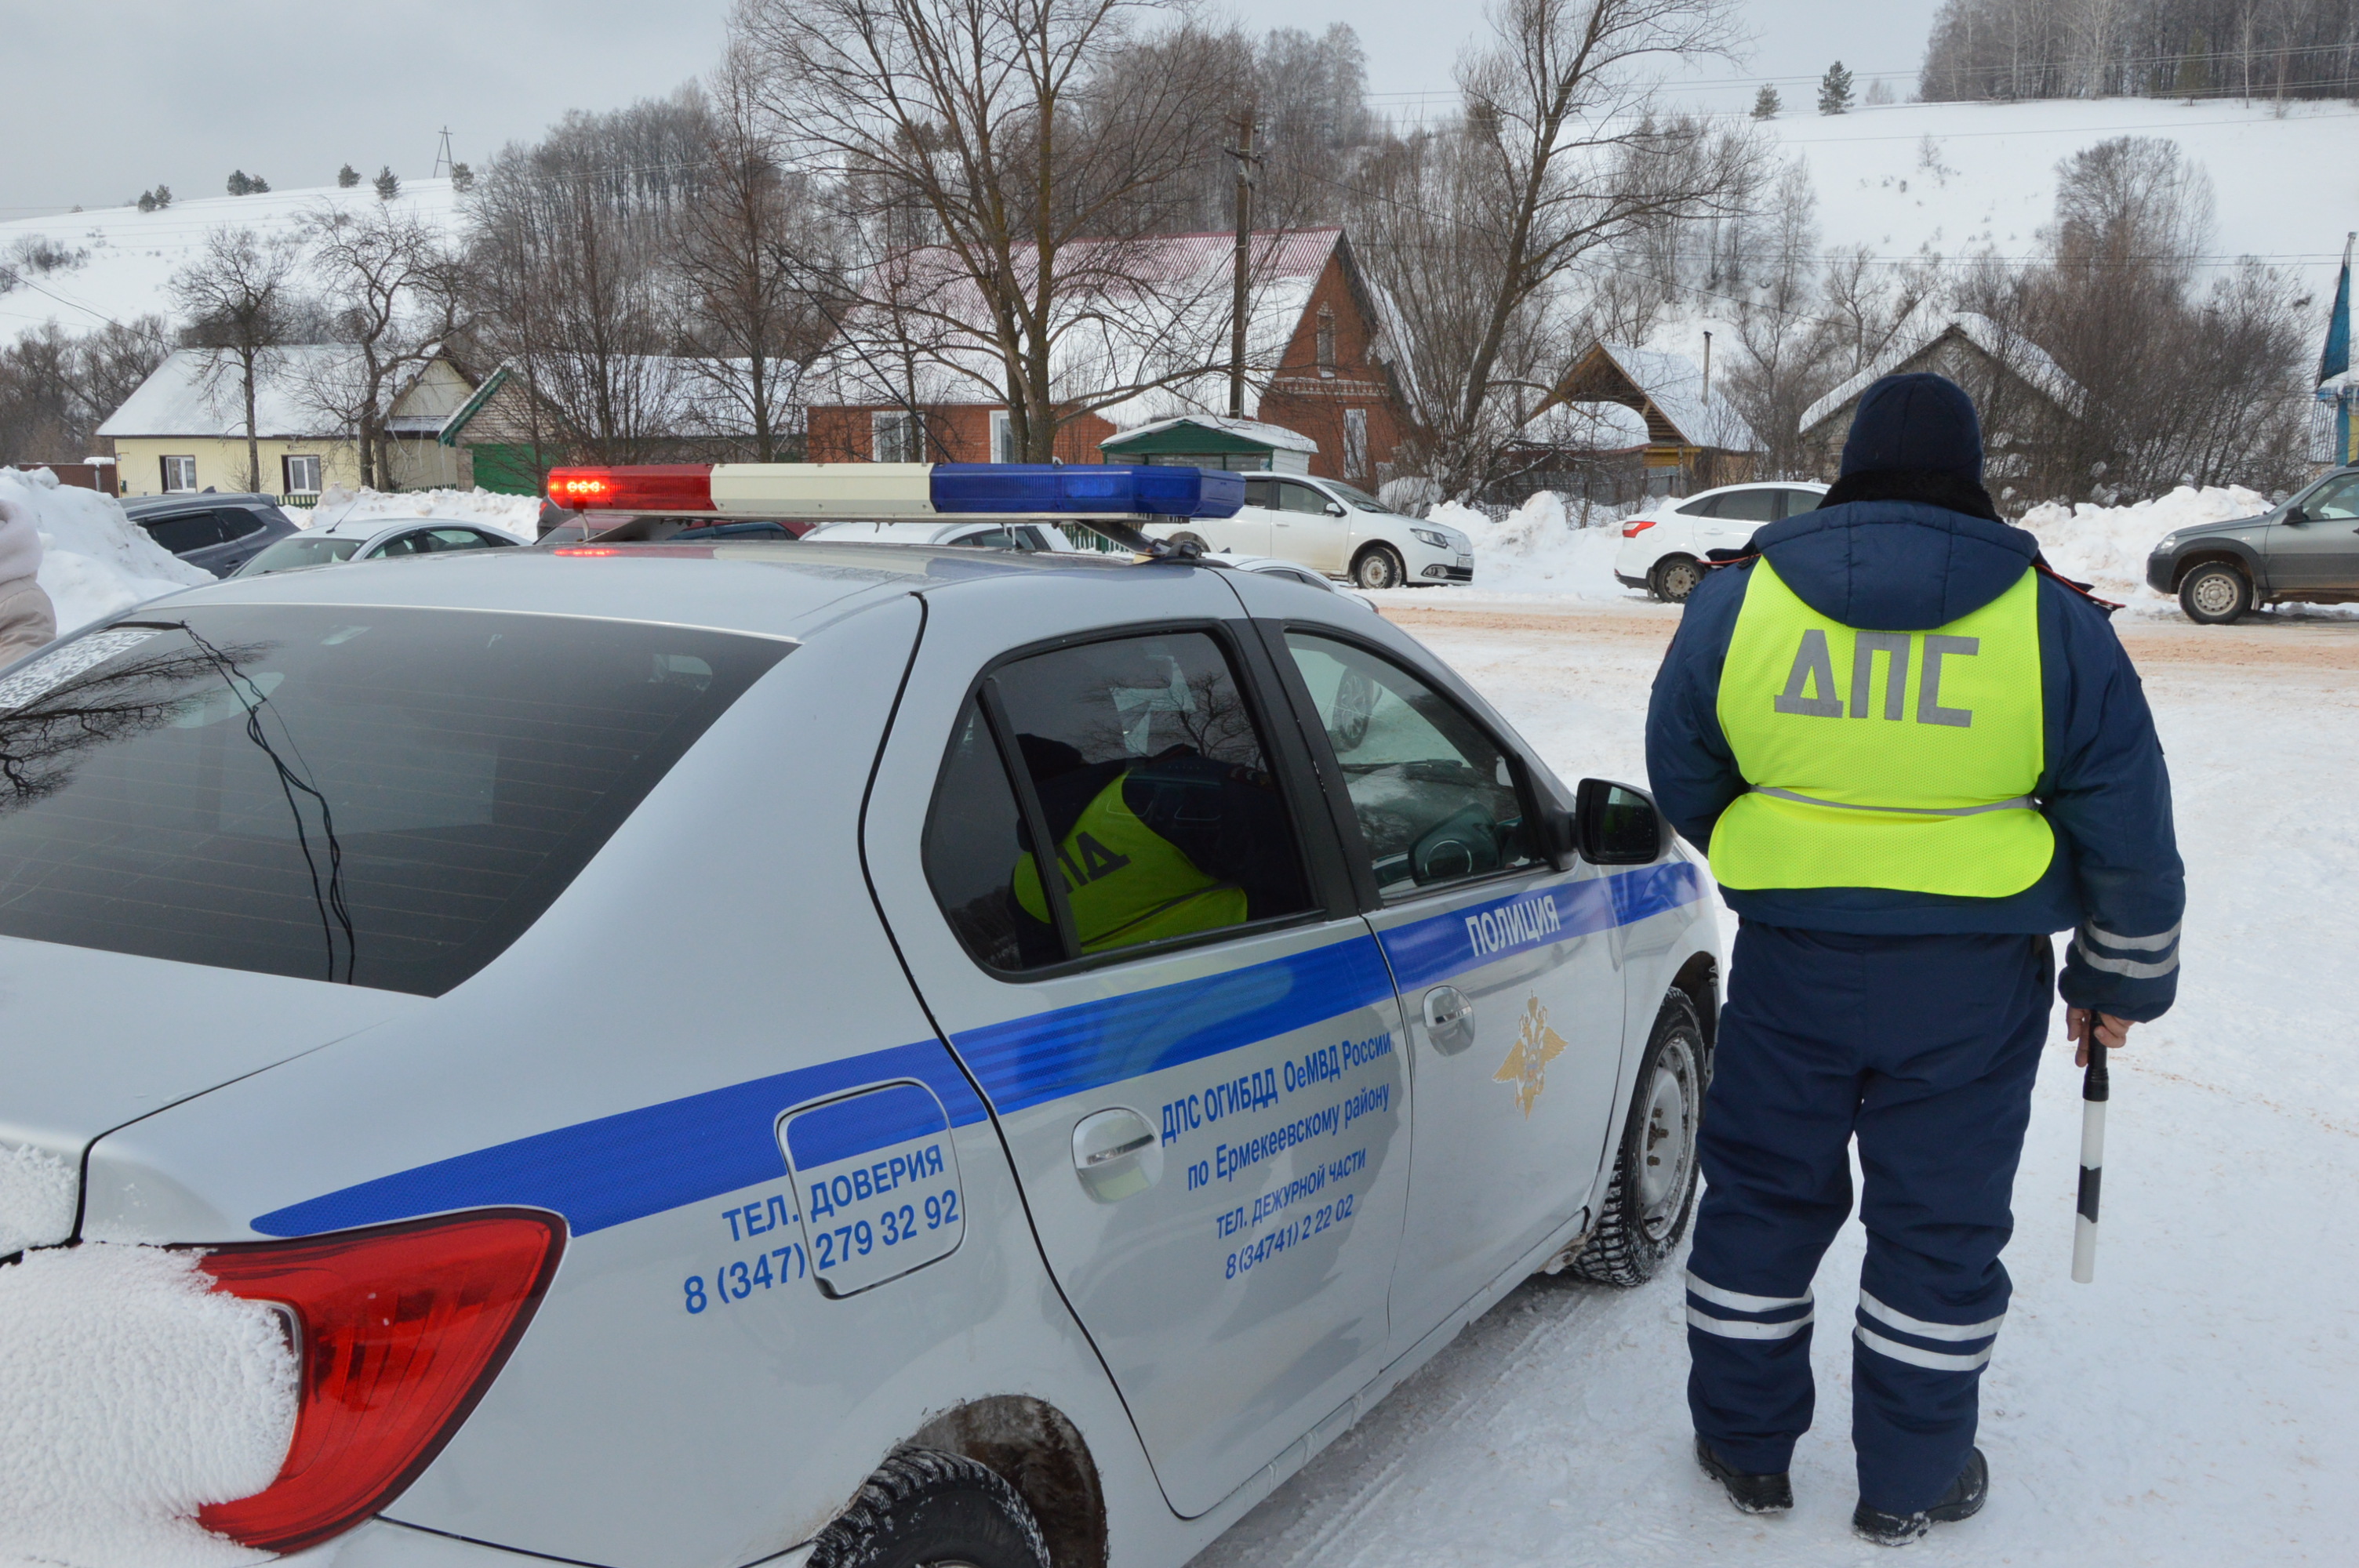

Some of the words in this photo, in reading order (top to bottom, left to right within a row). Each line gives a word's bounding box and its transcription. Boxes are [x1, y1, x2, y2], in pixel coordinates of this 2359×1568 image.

[1774, 629, 1979, 728] ДПС
[1465, 895, 1561, 957] ПОЛИЦИЯ
[1161, 1094, 1201, 1147] ДПС
[1204, 1068, 1278, 1122] ОГИБДД
[1284, 1044, 1340, 1092] ОеМВД
[1342, 1032, 1391, 1070] России
[1188, 1163, 1209, 1191] по
[1216, 1105, 1340, 1181] Ермекеевскому
[1345, 1083, 1389, 1128] району
[722, 1194, 799, 1242] ТЕЛ.
[810, 1144, 944, 1223] ДОВЕРИЯ
[1216, 1207, 1248, 1239] ТЕЛ.
[1252, 1163, 1325, 1228] ДЕЖУРНОЙ
[1329, 1148, 1366, 1182] ЧАСТИ
[1302, 1215, 1311, 1240] 2
[1314, 1204, 1332, 1234] 22
[1336, 1194, 1354, 1221] 02
[684, 1275, 707, 1314] 8
[718, 1243, 806, 1304] (347)
[815, 1220, 873, 1270] 279
[881, 1204, 918, 1246] 32
[925, 1189, 958, 1229] 92
